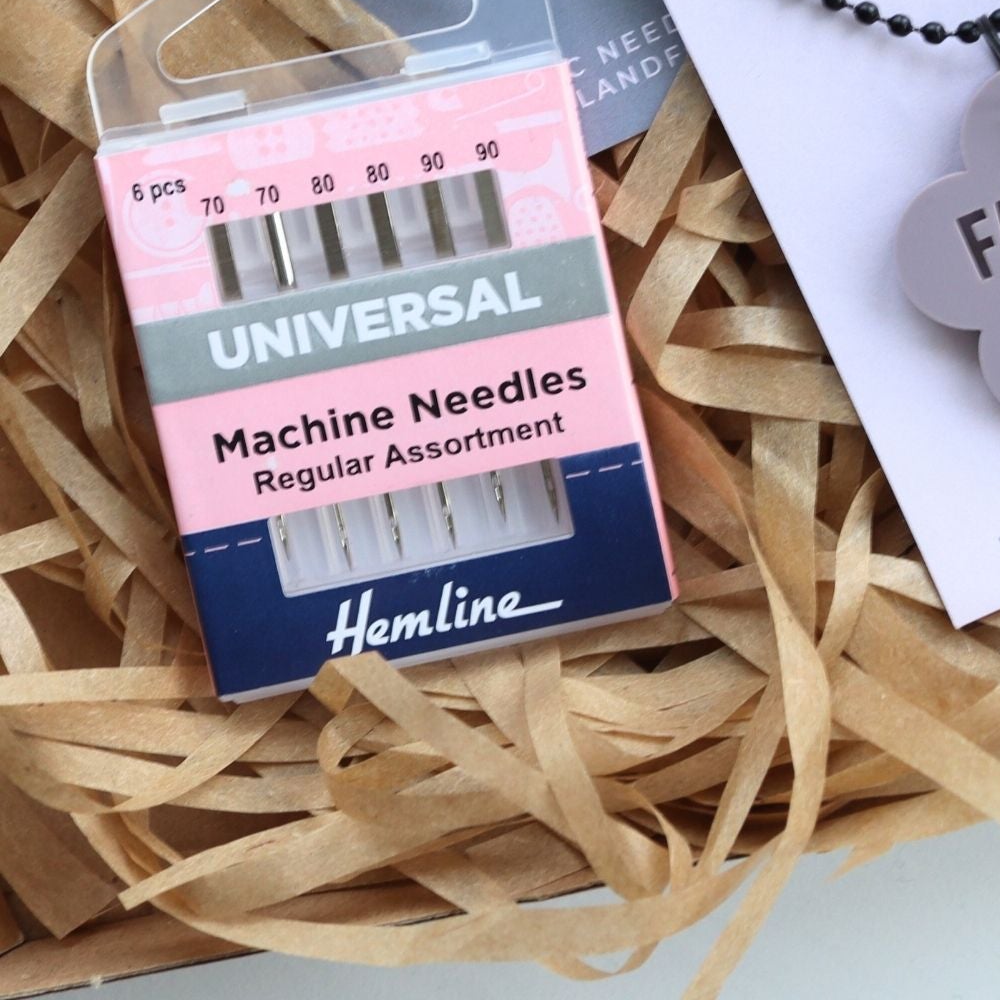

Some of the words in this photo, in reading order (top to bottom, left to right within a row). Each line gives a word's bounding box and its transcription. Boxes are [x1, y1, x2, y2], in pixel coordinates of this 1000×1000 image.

[575, 44, 682, 109] LANDF
[131, 182, 144, 202] 6
[150, 178, 187, 203] pcs
[200, 195, 225, 217] 70
[255, 184, 280, 206] 70
[311, 173, 335, 195] 80
[366, 162, 390, 184] 80
[420, 151, 444, 173] 90
[475, 140, 499, 162] 90
[207, 270, 543, 372] UNIVERSAL
[212, 406, 395, 464] Machine
[408, 366, 588, 424] Needles
[253, 452, 375, 496] Regular
[384, 411, 566, 469] Assortment
[325, 581, 564, 657] Hemline
